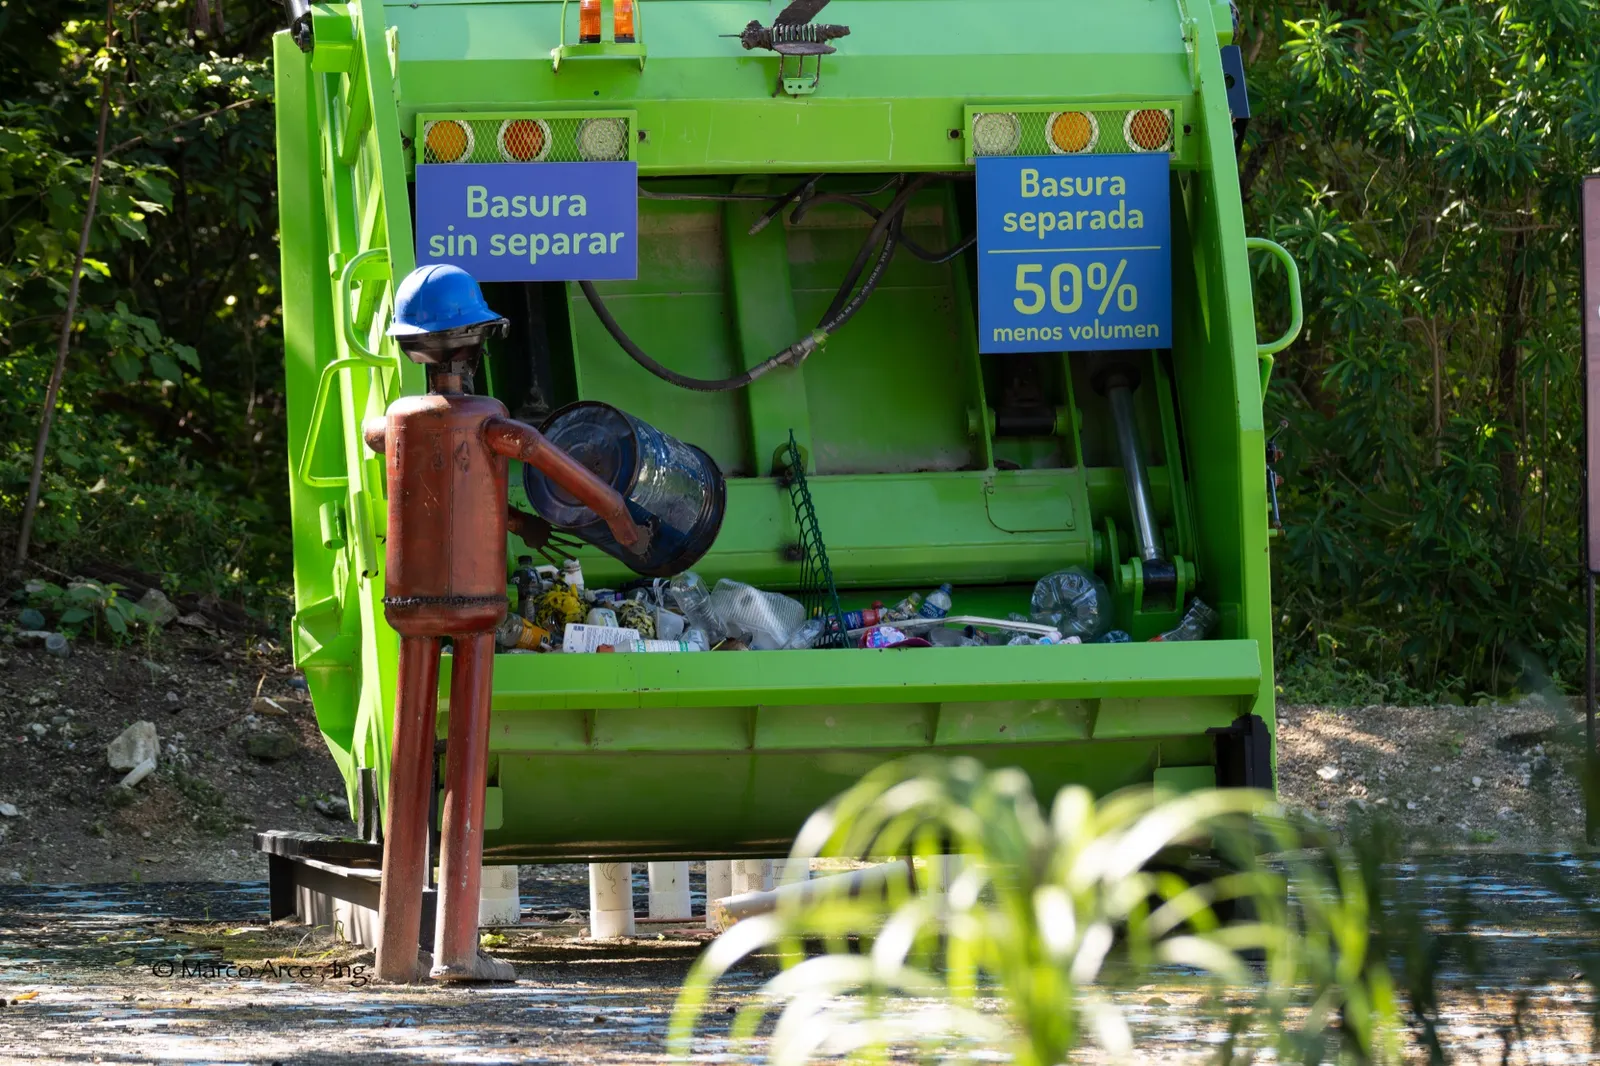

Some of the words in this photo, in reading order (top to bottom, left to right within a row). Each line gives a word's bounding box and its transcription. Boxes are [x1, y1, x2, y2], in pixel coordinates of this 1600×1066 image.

[1020, 168, 1126, 198] Basura
[466, 185, 587, 218] Basura
[1003, 199, 1144, 240] separada
[428, 225, 478, 257] sin
[489, 231, 625, 265] separar
[1013, 258, 1138, 315] 50%
[993, 326, 1063, 342] menos
[1069, 318, 1159, 340] volumen
